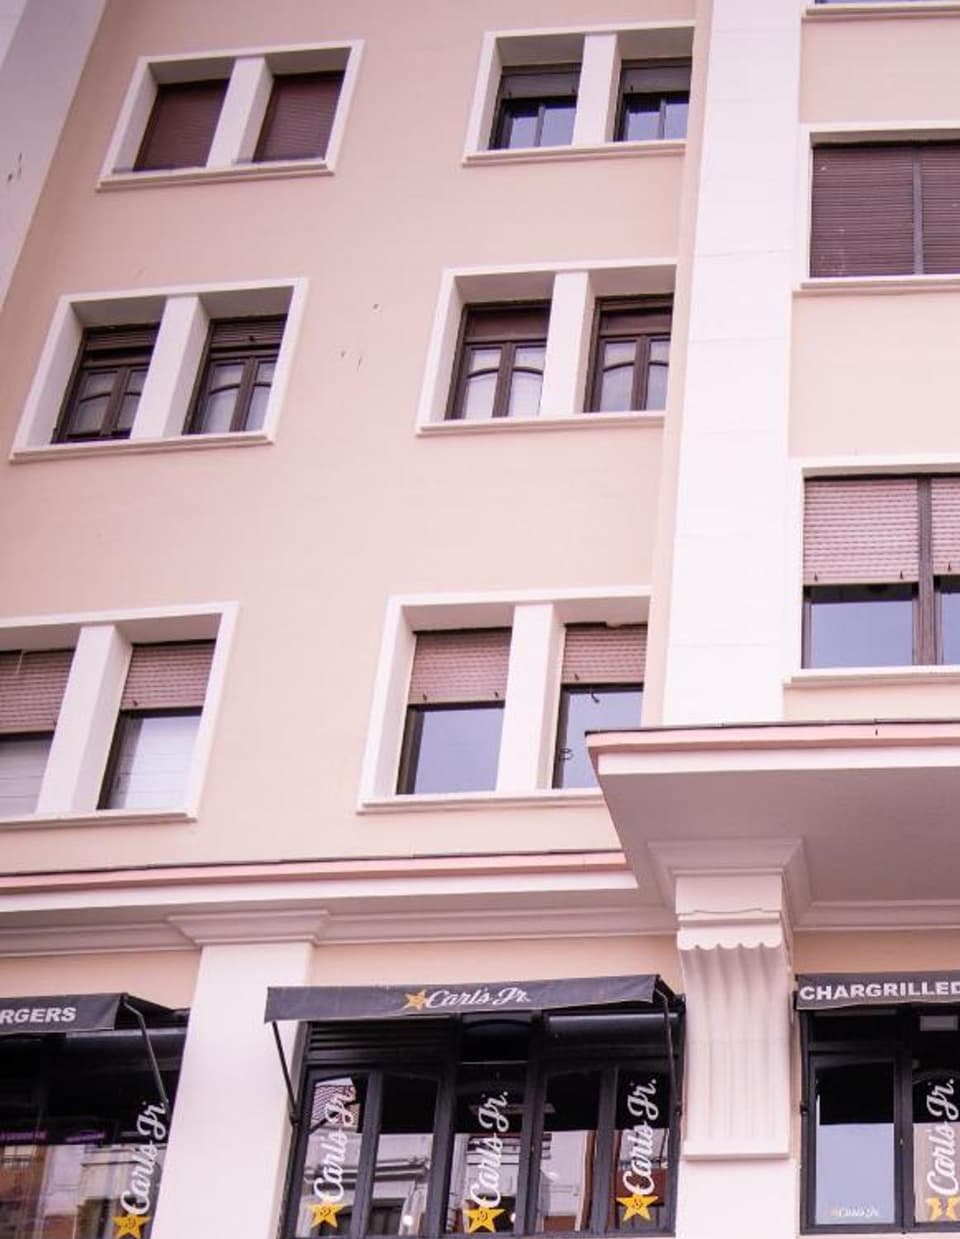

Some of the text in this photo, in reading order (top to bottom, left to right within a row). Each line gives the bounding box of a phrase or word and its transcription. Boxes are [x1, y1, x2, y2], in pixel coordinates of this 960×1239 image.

[425, 988, 491, 1008] Carl's
[121, 1141, 158, 1215] Carl's
[313, 1129, 348, 1203] Carl's
[470, 1091, 509, 1207] Carl's Jr.
[622, 1078, 659, 1195] Carl's Jr.
[926, 1079, 959, 1196] Carl's Jr.
